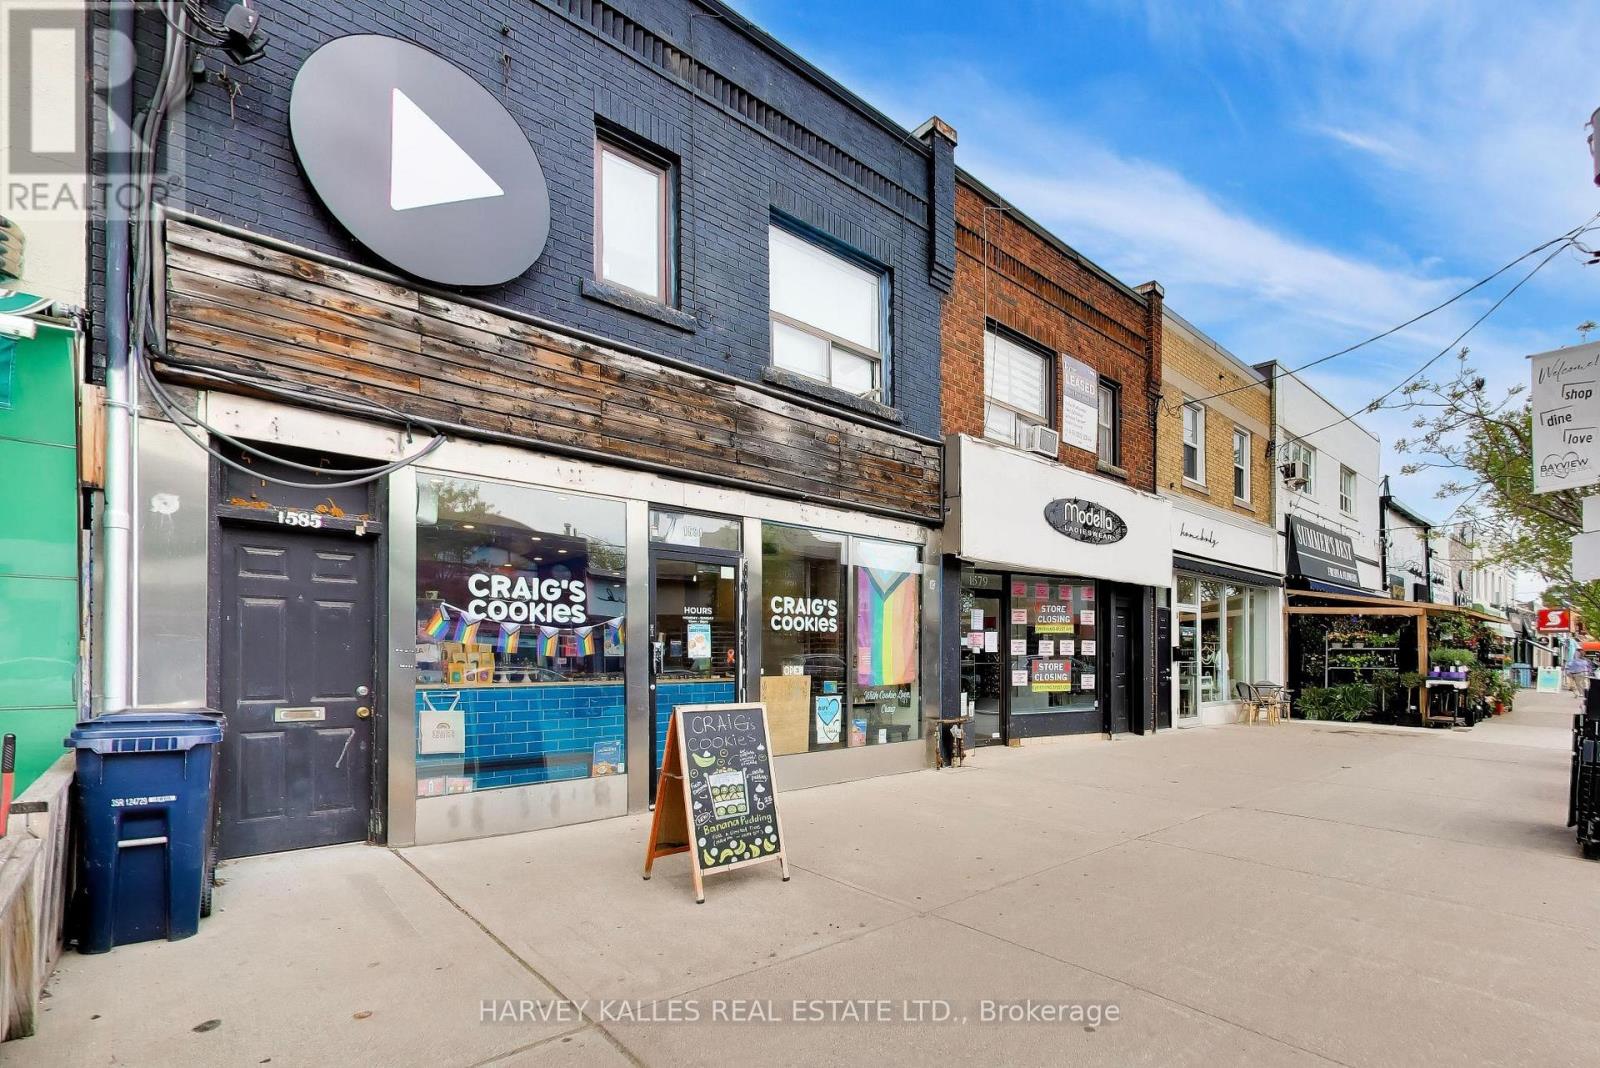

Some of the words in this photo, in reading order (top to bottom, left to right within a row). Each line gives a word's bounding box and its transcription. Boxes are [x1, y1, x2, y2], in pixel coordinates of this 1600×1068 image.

[1564, 387, 1593, 400] shop
[1547, 413, 1573, 427] dine
[1568, 433, 1593, 445] love
[1540, 458, 1589, 472] BAYVIEW
[278, 511, 322, 529] 1585
[1064, 502, 1113, 531] Modella
[467, 573, 587, 602] CRAIG'S
[683, 606, 713, 615] HOURS
[770, 596, 838, 617] CRAIG'S
[1041, 605, 1067, 613] STORE
[1037, 615, 1071, 624] CLOSING
[1039, 662, 1064, 671] STORE
[1034, 673, 1068, 682] CLOSING
[703, 819, 739, 836] Banana
[740, 814, 772, 827] Pudding
